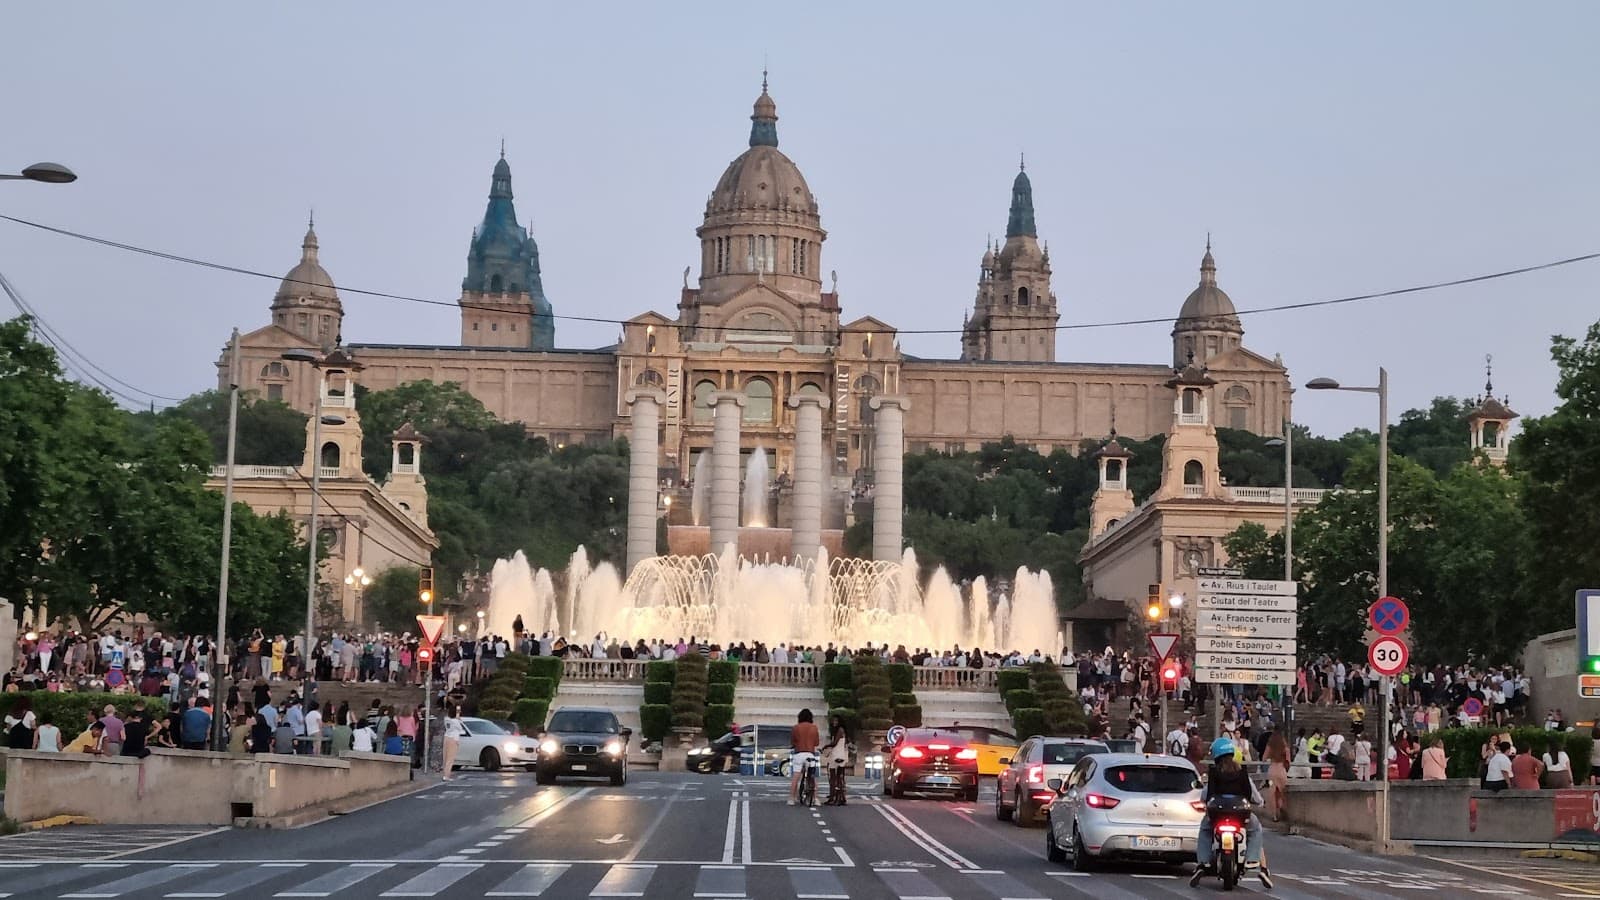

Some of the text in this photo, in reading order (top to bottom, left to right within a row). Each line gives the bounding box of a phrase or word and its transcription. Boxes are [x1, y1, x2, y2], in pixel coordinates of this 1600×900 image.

[667, 369, 679, 426] TURNER
[836, 373, 849, 431] TURNER
[1211, 581, 1224, 589] Av.
[1226, 582, 1244, 590] Rius
[1252, 582, 1277, 591] Taulet
[1210, 596, 1279, 606] Ciutat del Teatre
[1211, 614, 1292, 624] Av. Francesc Ferrer
[1210, 640, 1274, 651] Poble Espanyol
[1210, 656, 1277, 665] Palau Sant Jordi
[1377, 649, 1399, 662] 30
[1209, 671, 1235, 680] Estadi
[1139, 838, 1159, 847] 7005
